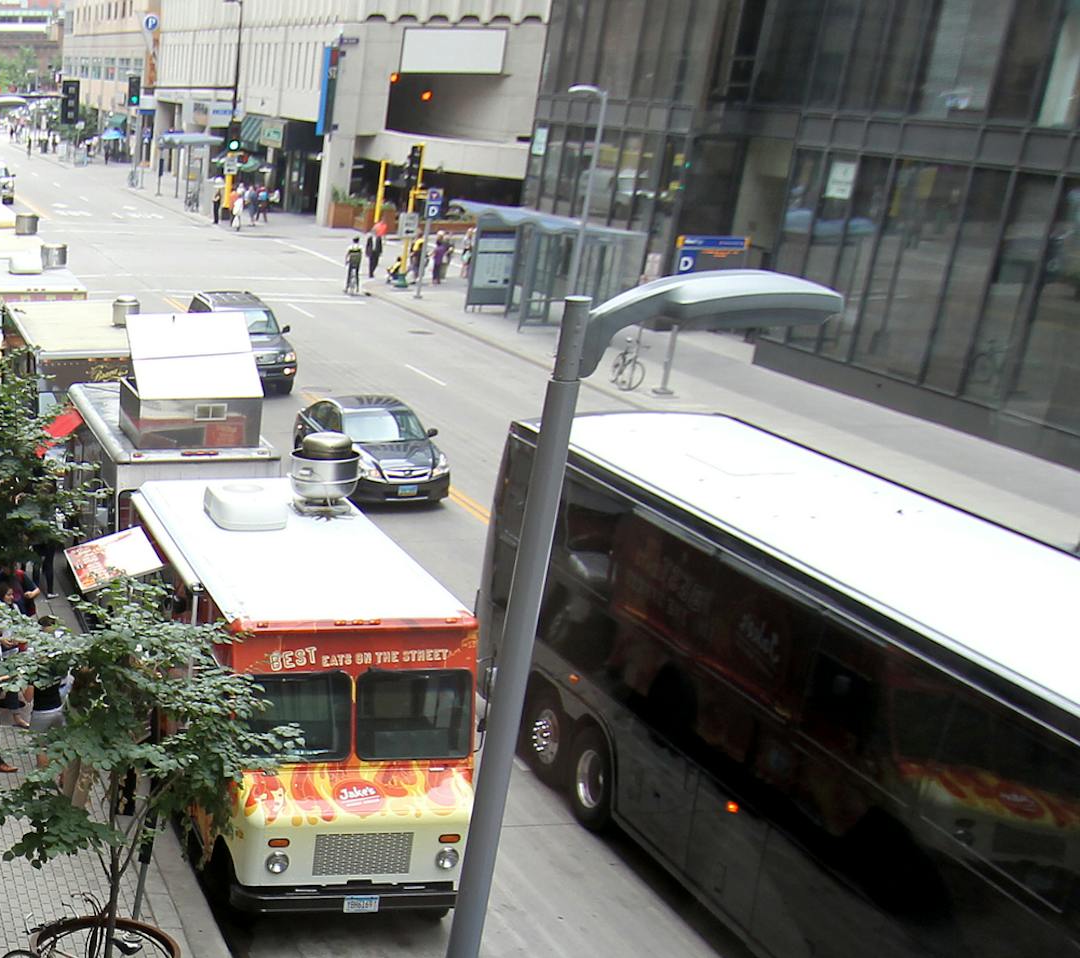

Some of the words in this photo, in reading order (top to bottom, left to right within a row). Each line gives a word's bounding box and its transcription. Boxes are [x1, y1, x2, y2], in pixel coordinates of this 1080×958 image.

[428, 205, 438, 217] D
[680, 256, 694, 271] D
[270, 646, 318, 672] BEST
[321, 654, 352, 668] EATS
[355, 653, 373, 665] ON
[374, 650, 400, 665] THE
[402, 648, 449, 663] STREET
[339, 785, 377, 800] Jake's
